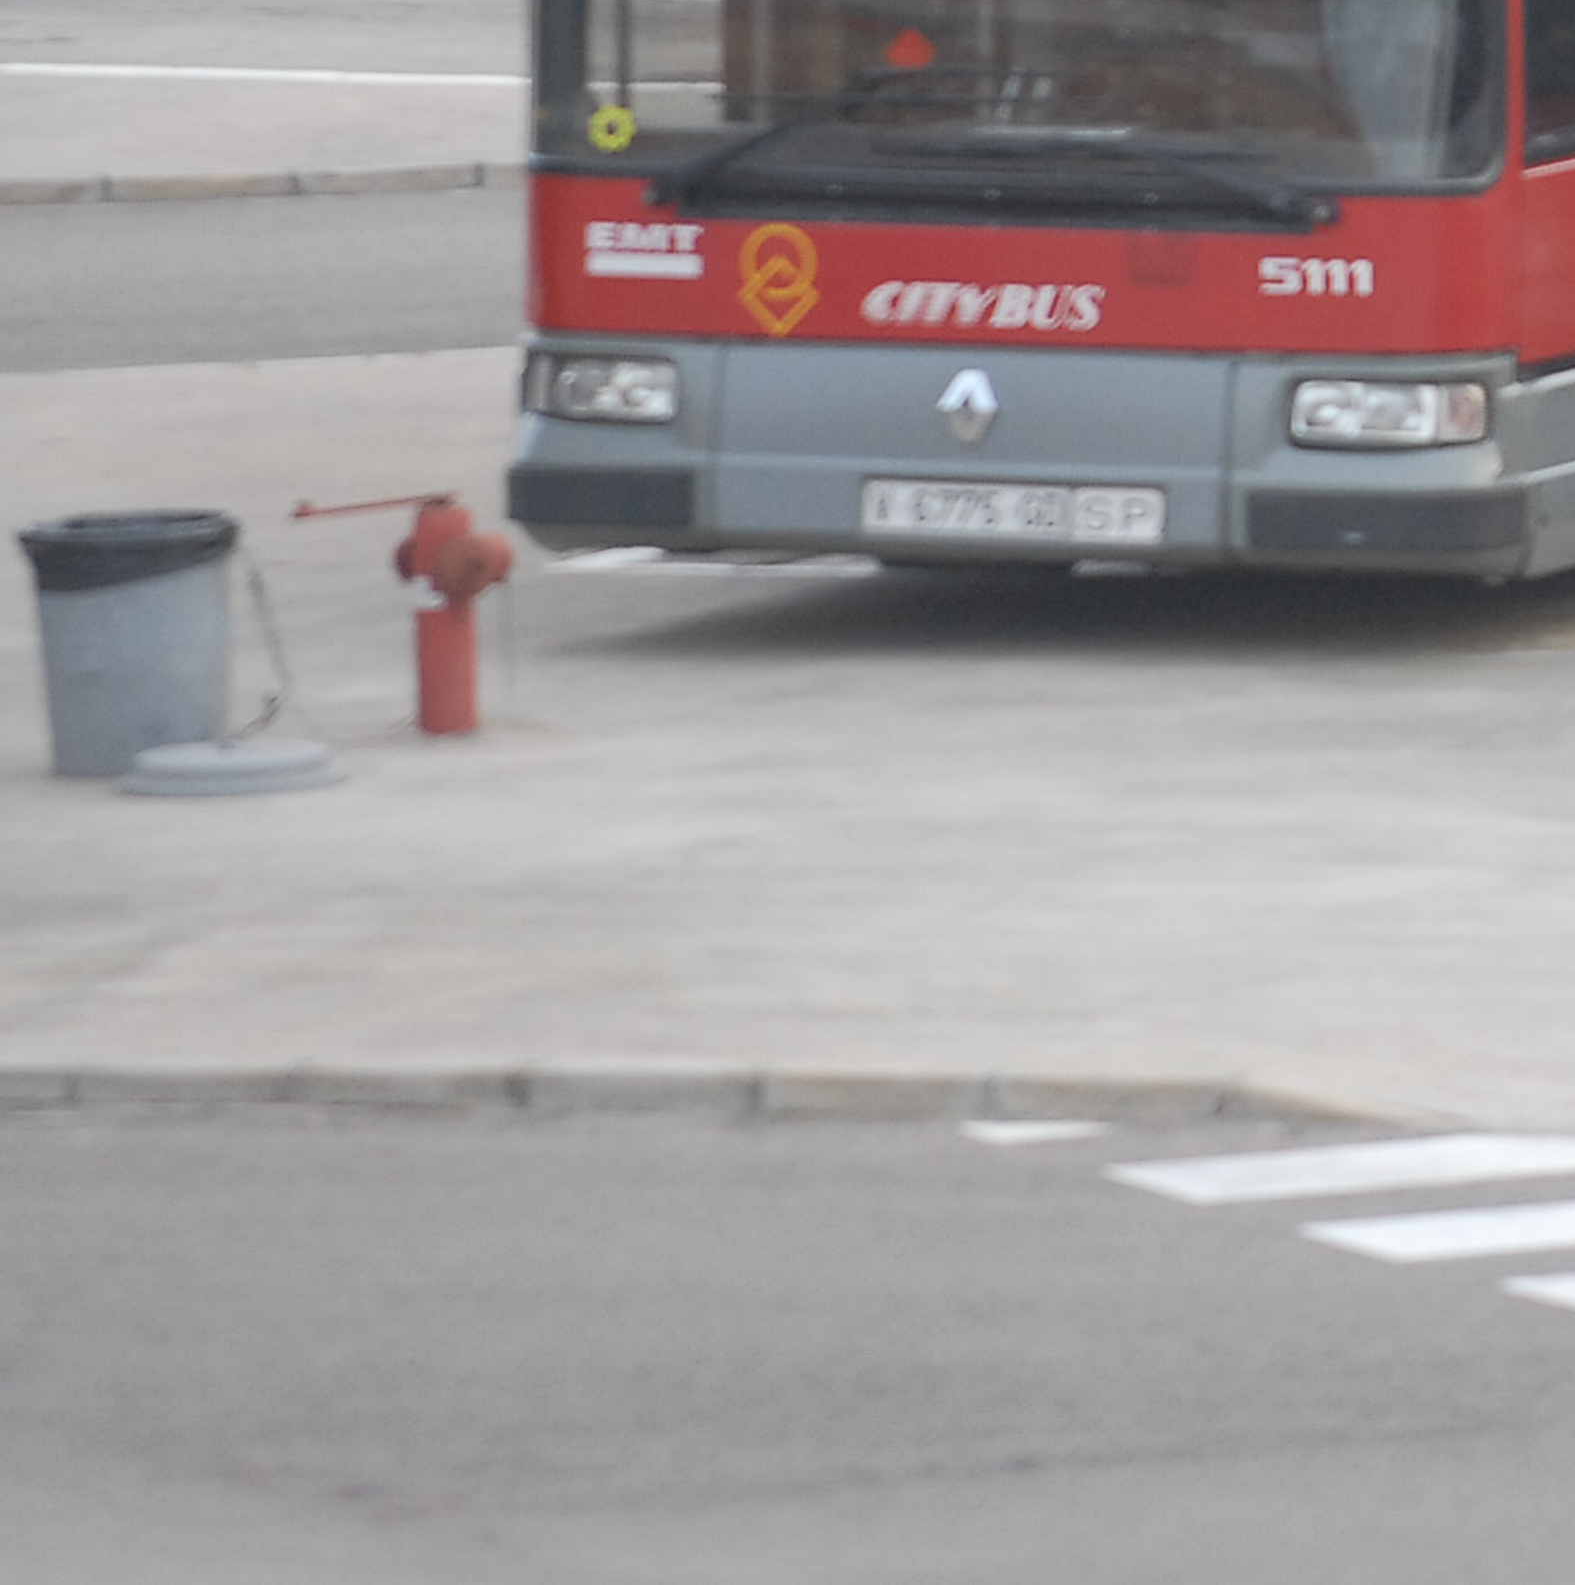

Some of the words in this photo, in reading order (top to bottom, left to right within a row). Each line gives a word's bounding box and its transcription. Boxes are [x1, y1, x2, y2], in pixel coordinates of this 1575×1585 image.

[584, 220, 704, 253] EMT
[1258, 256, 1374, 296] 5111
[860, 280, 1104, 331] CITYBUS
